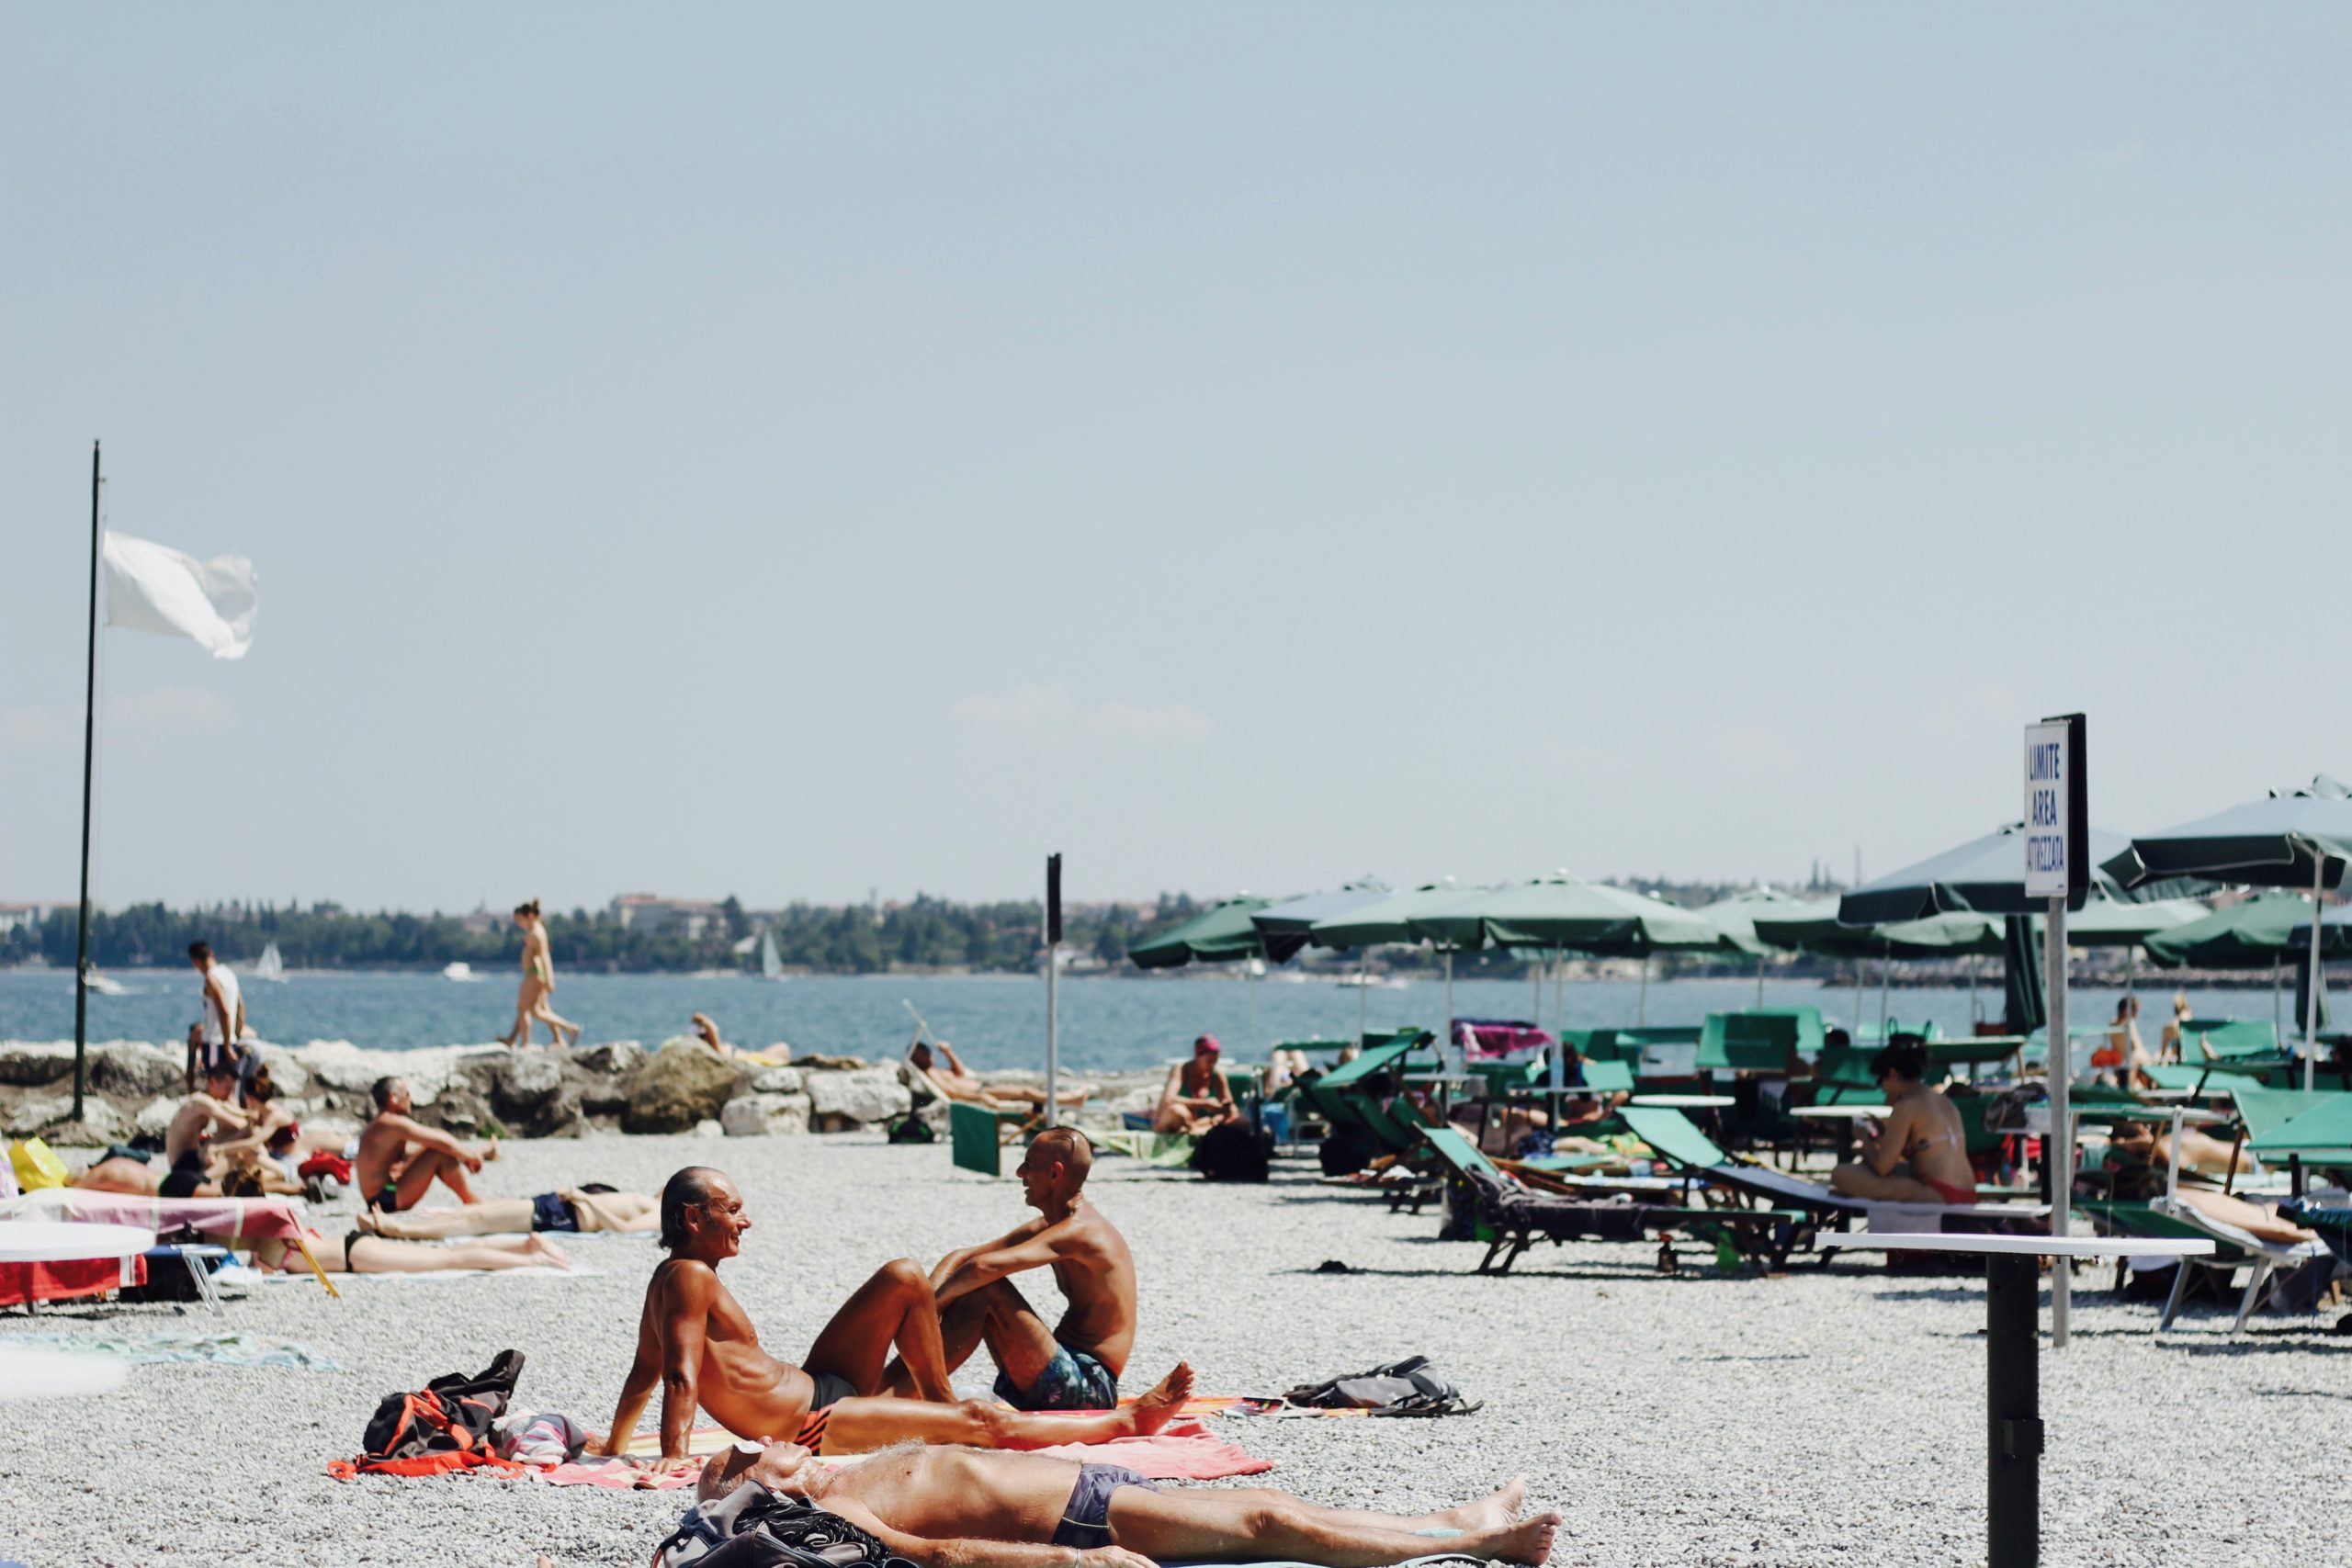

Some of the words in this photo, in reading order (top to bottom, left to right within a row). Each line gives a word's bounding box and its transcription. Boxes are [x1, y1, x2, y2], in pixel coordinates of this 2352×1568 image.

[2030, 743, 2060, 781] LIMITE
[2032, 790, 2057, 827] AREA
[2028, 836, 2064, 872] ATTREZZATA
